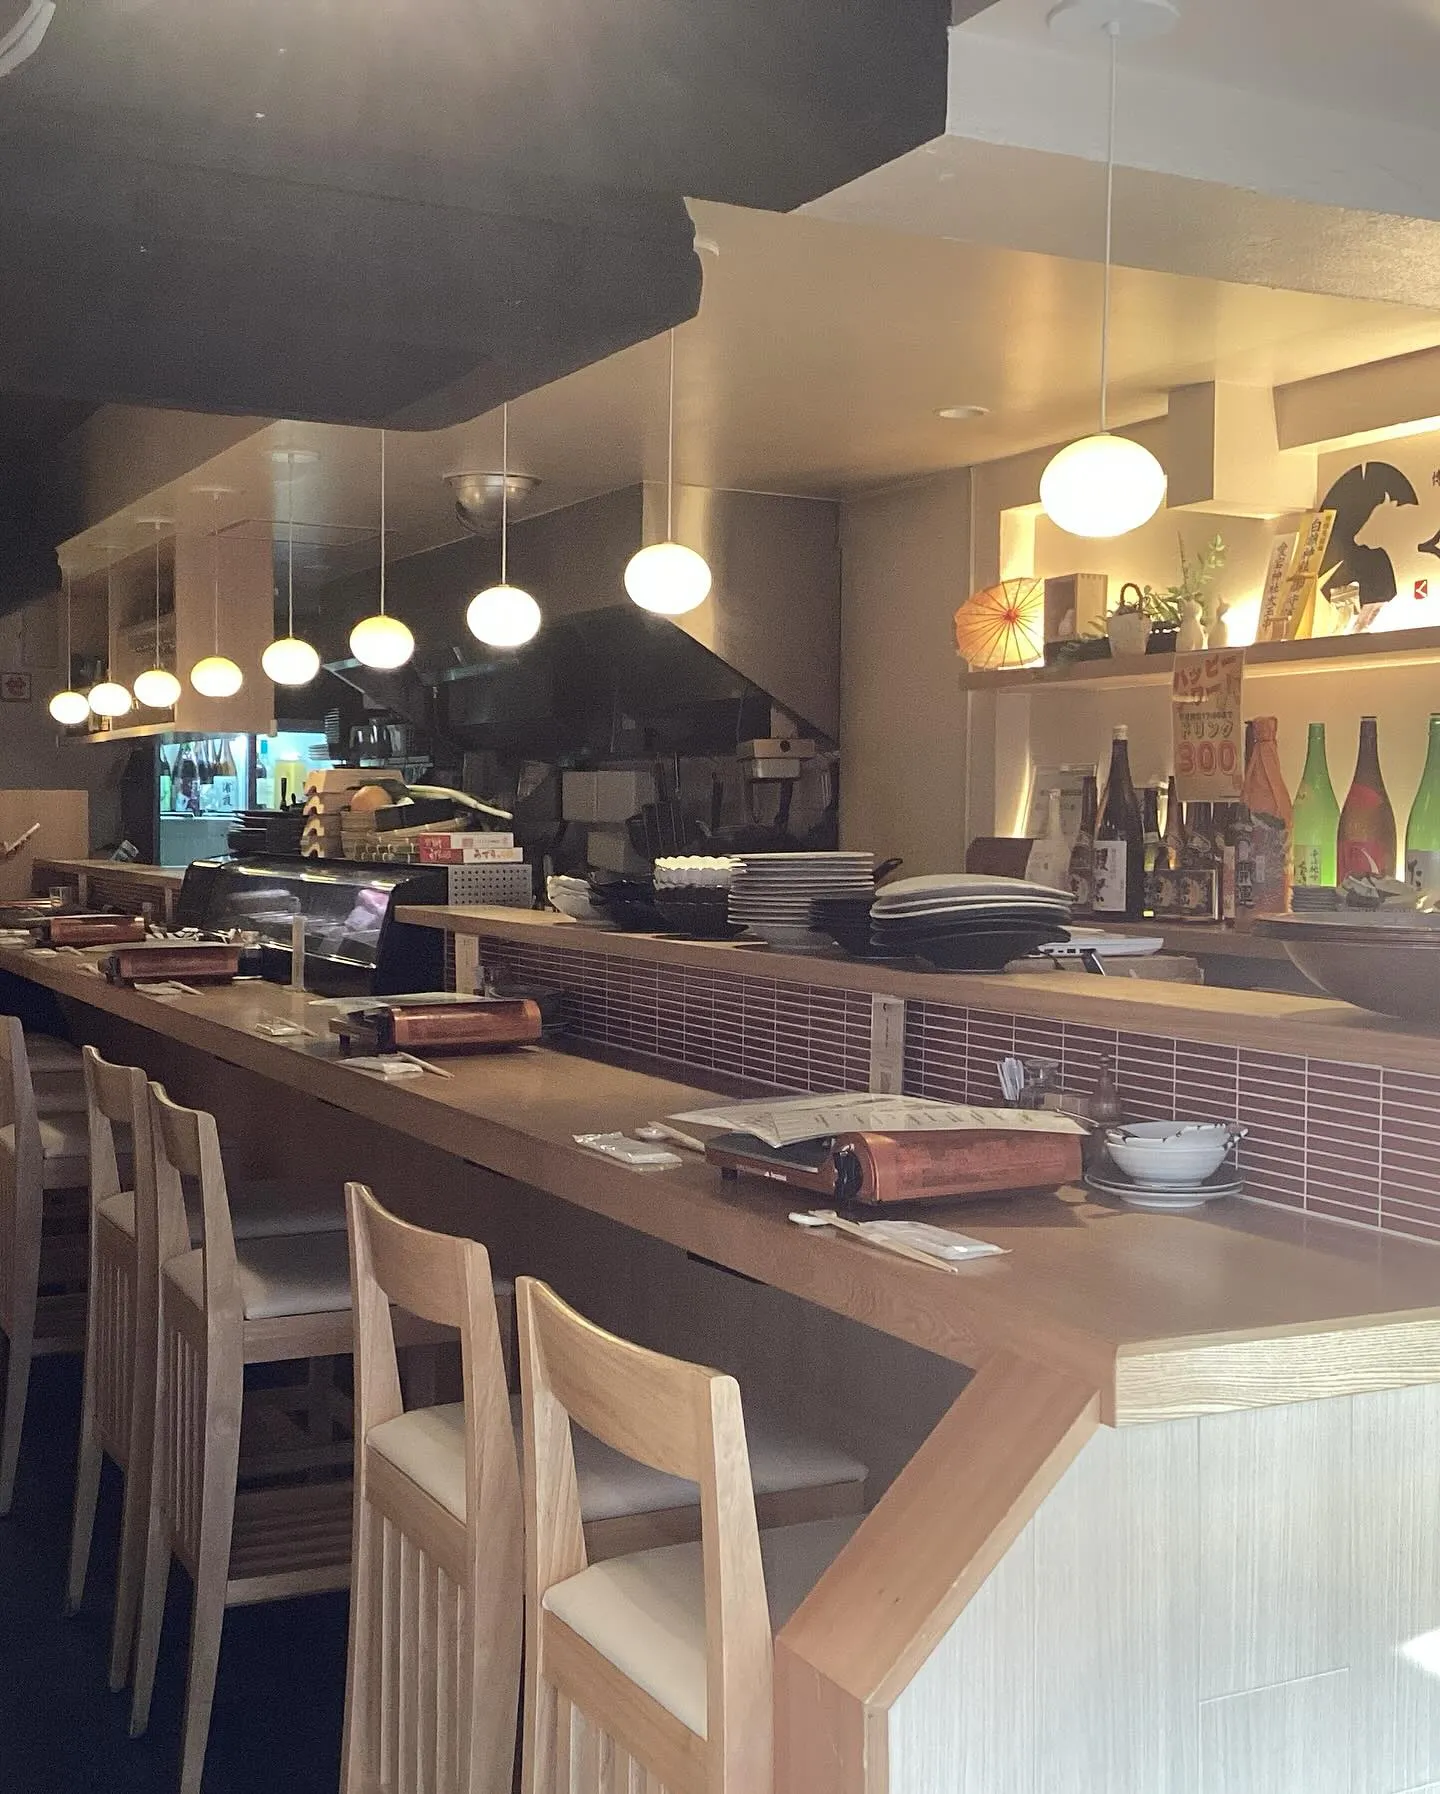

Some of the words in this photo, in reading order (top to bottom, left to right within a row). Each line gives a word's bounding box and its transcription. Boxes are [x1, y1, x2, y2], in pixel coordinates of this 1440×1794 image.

[1181, 721, 1234, 740] ドリンク
[1178, 740, 1238, 776] 300
